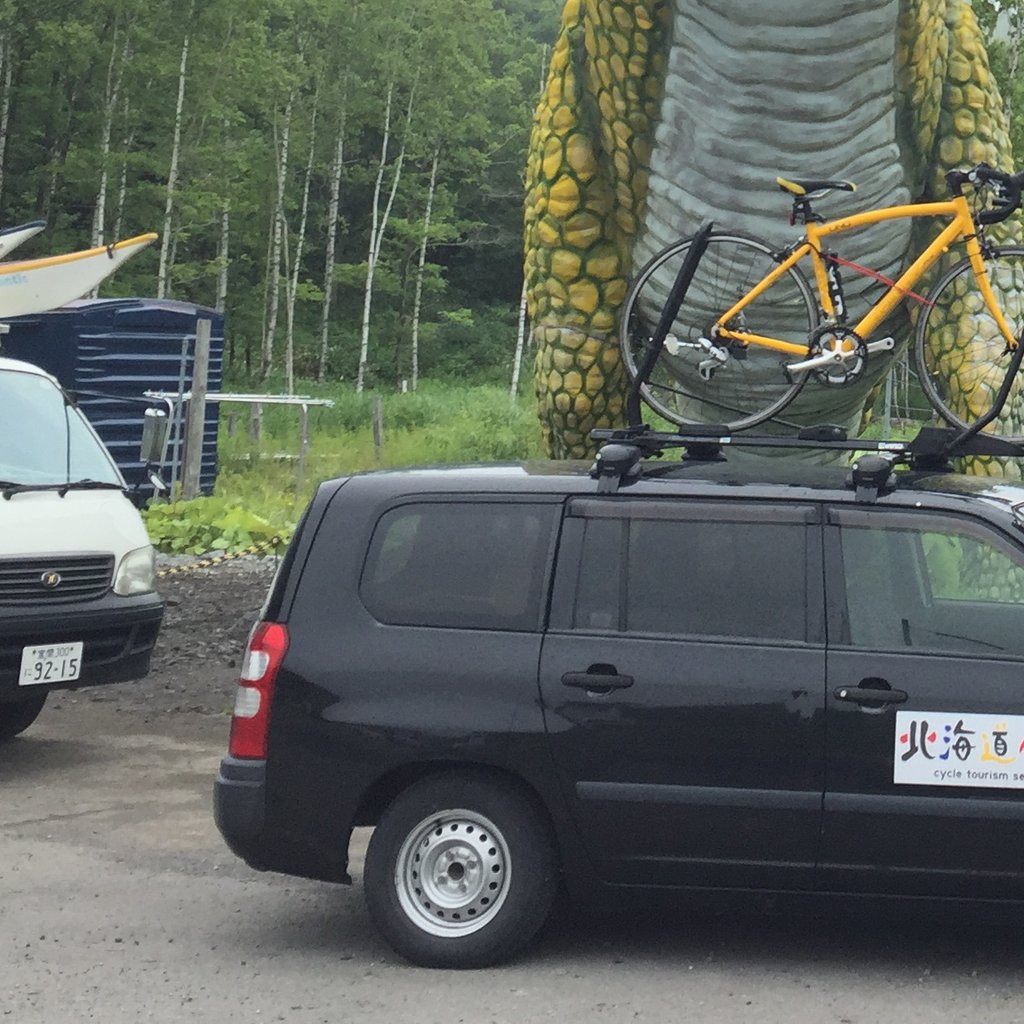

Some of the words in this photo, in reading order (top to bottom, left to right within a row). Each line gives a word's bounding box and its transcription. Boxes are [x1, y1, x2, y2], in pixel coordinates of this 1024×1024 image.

[34, 658, 78, 681] 92-15
[934, 769, 962, 781] cycle
[967, 770, 1008, 781] tourism
